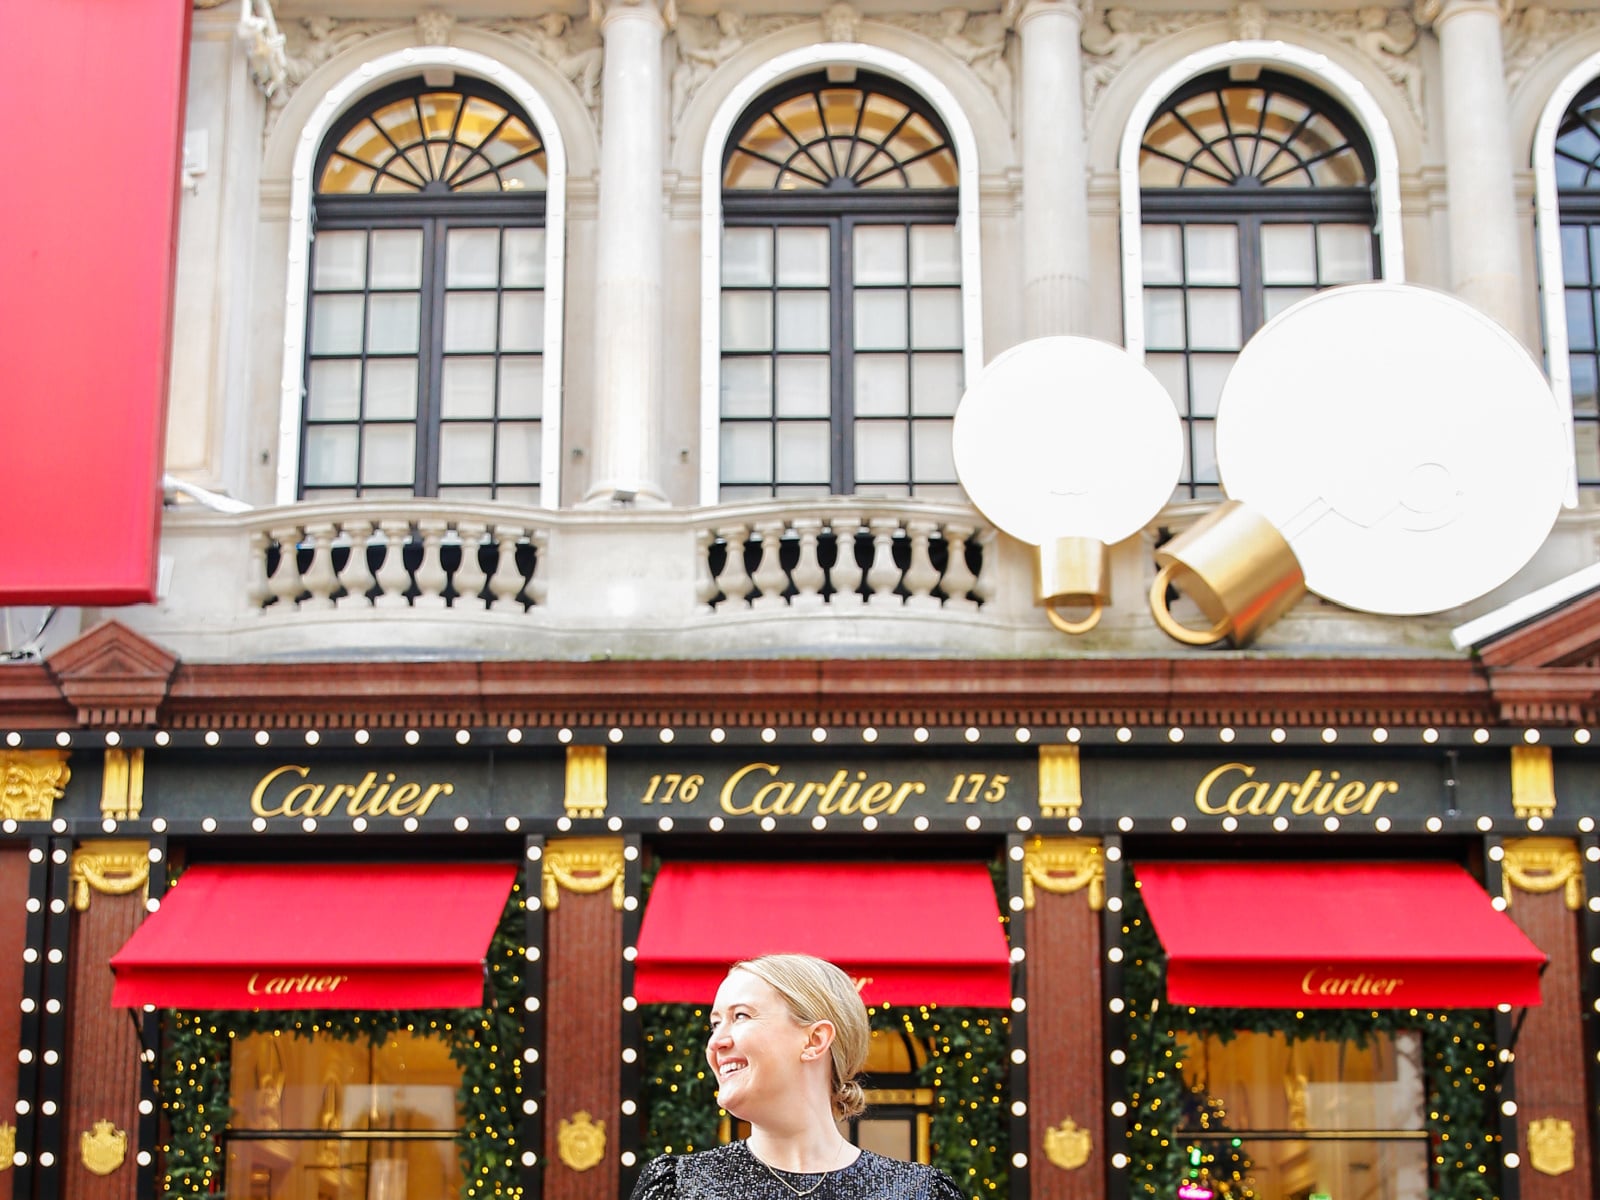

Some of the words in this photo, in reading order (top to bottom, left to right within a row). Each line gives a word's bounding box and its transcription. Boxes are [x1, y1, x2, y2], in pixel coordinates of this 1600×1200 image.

[250, 764, 455, 818] Cartier
[641, 774, 705, 804] 176
[719, 762, 926, 816] Cartier
[946, 773, 1010, 803] 175
[1194, 762, 1400, 816] Cartier
[1301, 966, 1405, 996] Cartier
